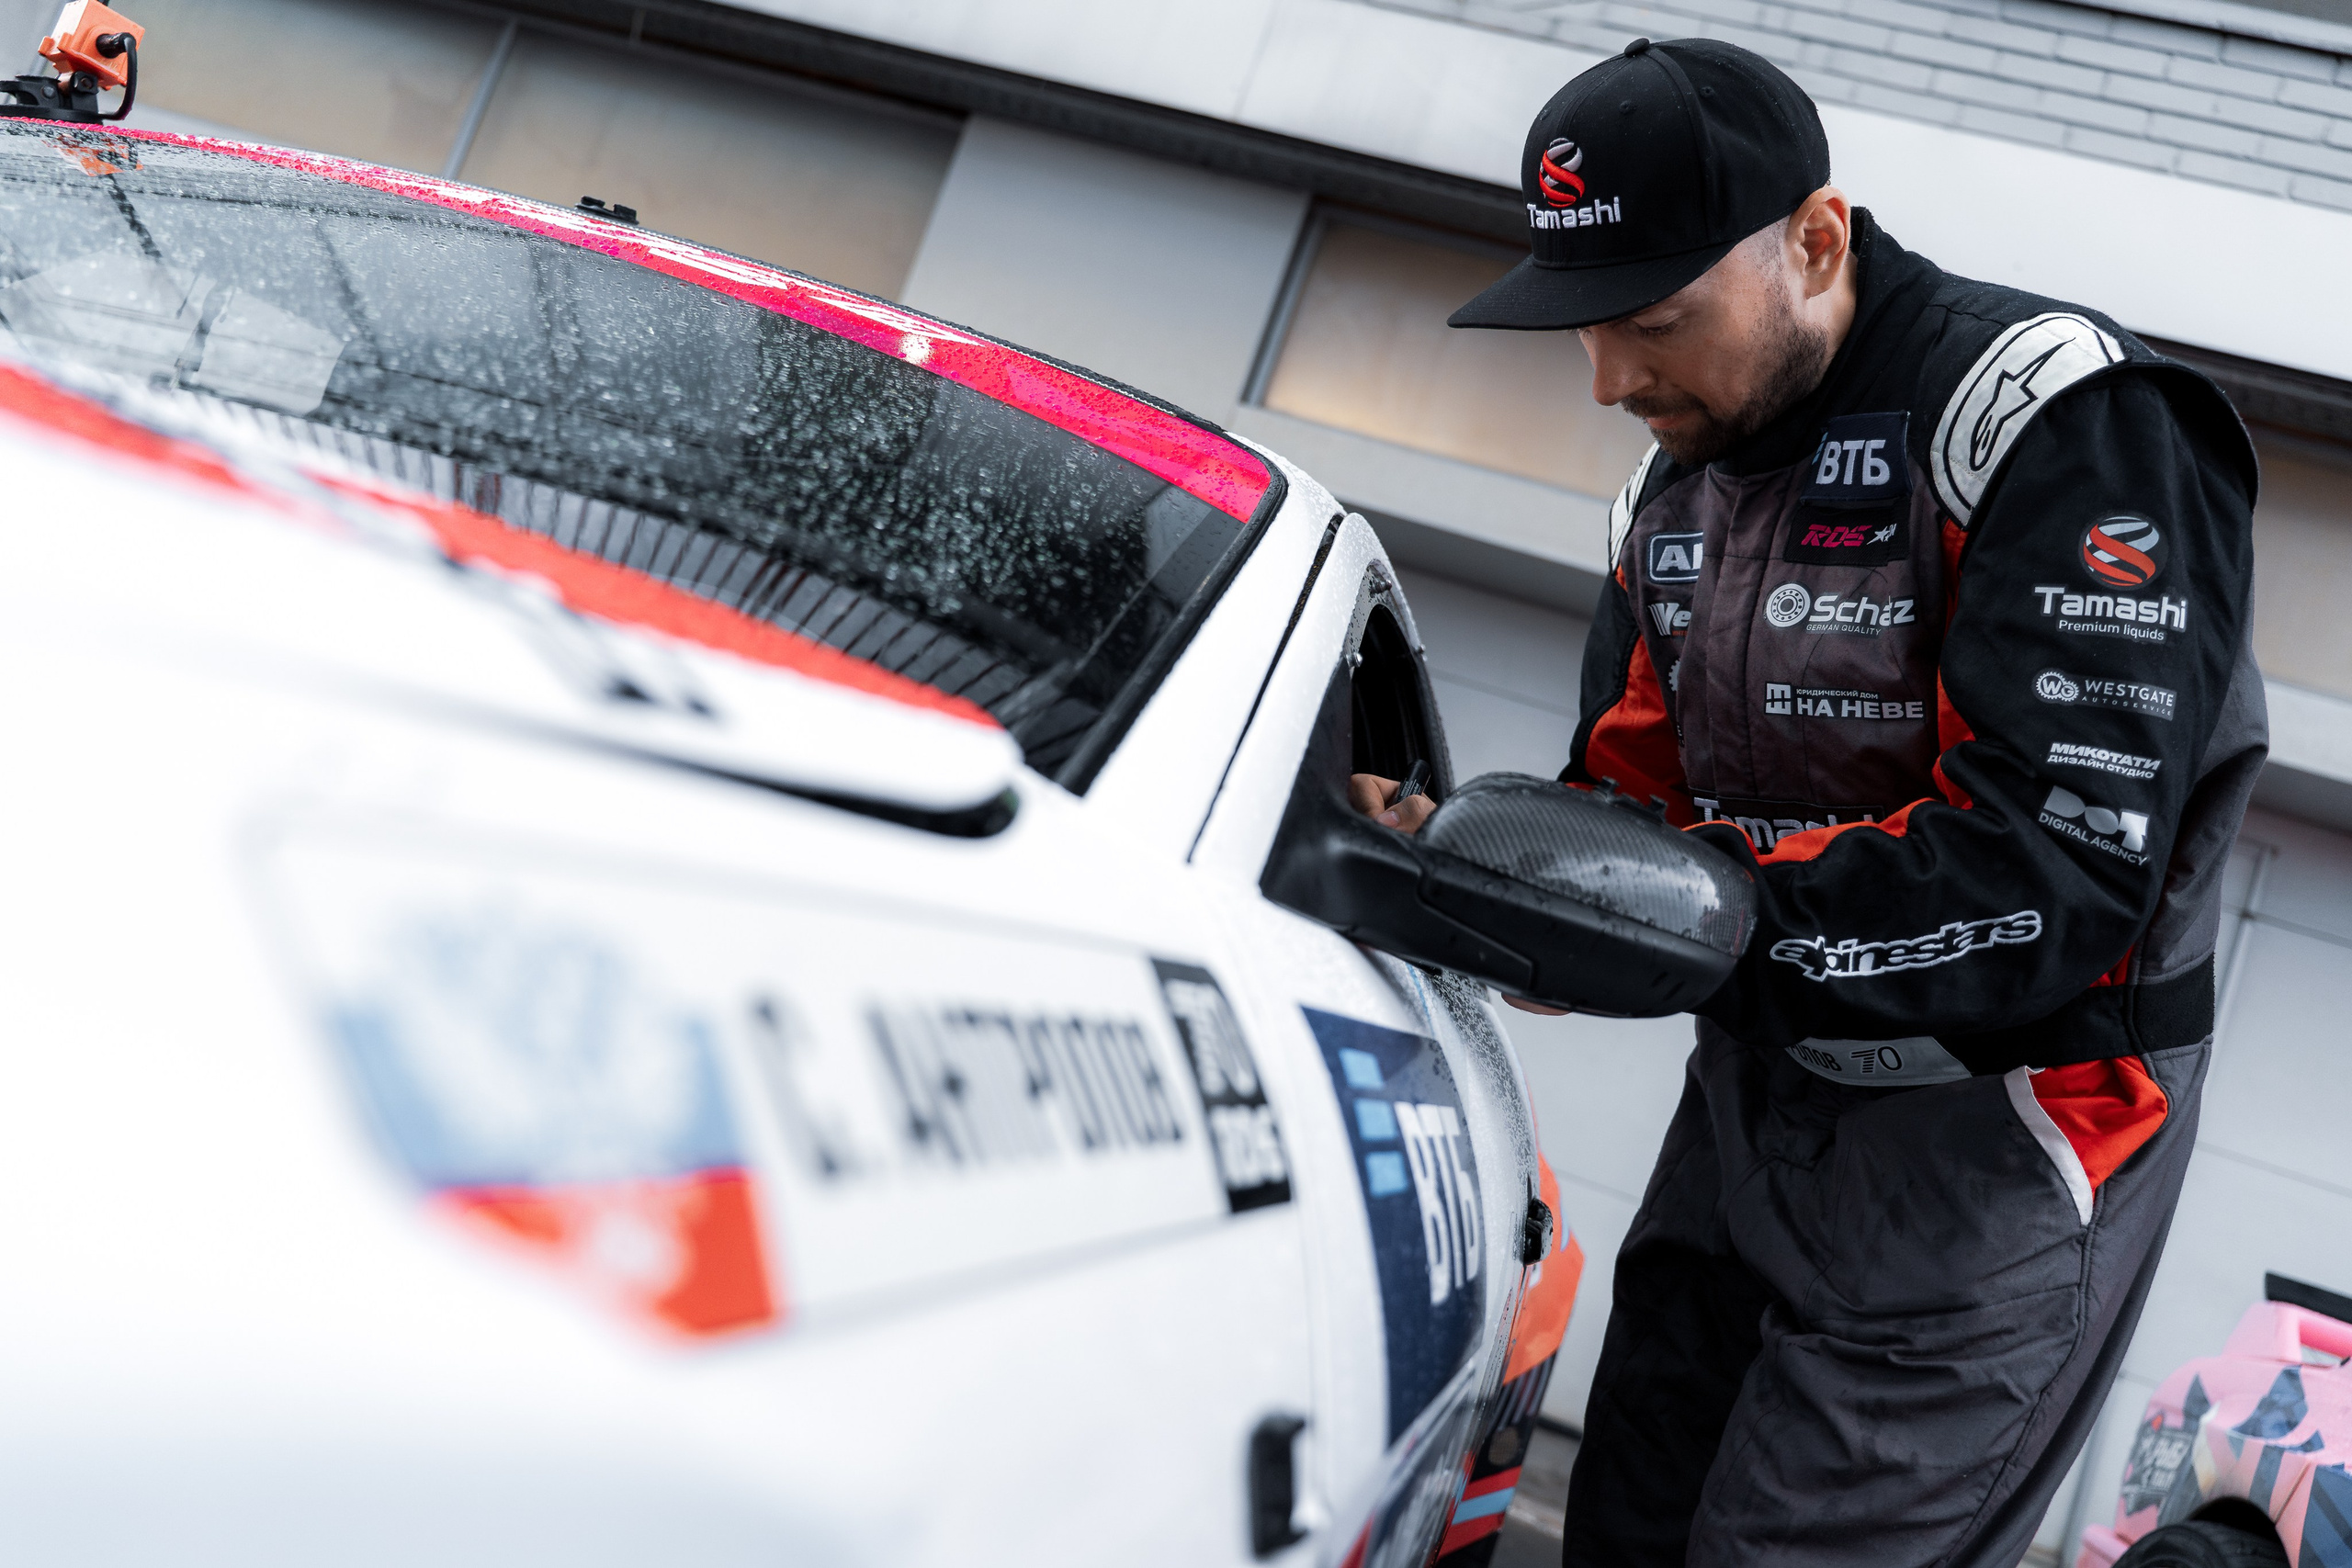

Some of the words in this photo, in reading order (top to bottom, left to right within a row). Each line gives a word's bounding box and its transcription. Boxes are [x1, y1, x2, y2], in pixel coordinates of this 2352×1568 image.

[1526, 196, 1622, 230] Tamashi
[1815, 439, 1891, 486] ВТБ
[1801, 524, 1873, 548] RDS
[2034, 586, 2187, 629] Tamashi
[1806, 624, 1839, 632] GERMAN
[1841, 625, 1882, 636] QUALITY
[2059, 619, 2120, 634] Premium
[2123, 624, 2165, 641] liquids
[1796, 688, 1859, 697] ЮРИДИЧЕСКИЙ
[1860, 692, 1879, 700] ДОМ
[2082, 695, 2172, 716] AUTOSERVICE
[2085, 679, 2175, 707] WESTGATE
[1797, 697, 1834, 717] НА
[1841, 699, 1924, 719] НЕВЕ
[2047, 754, 2105, 770] ДИЗАЙН
[2106, 763, 2154, 779] СТУДИО
[2050, 742, 2162, 771] МИКОТАТИ
[2038, 812, 2089, 842] DIGITAL
[2090, 836, 2150, 866] AGENCY
[1851, 1045, 1903, 1074] 70
[1393, 1101, 1481, 1307] ВТБ
